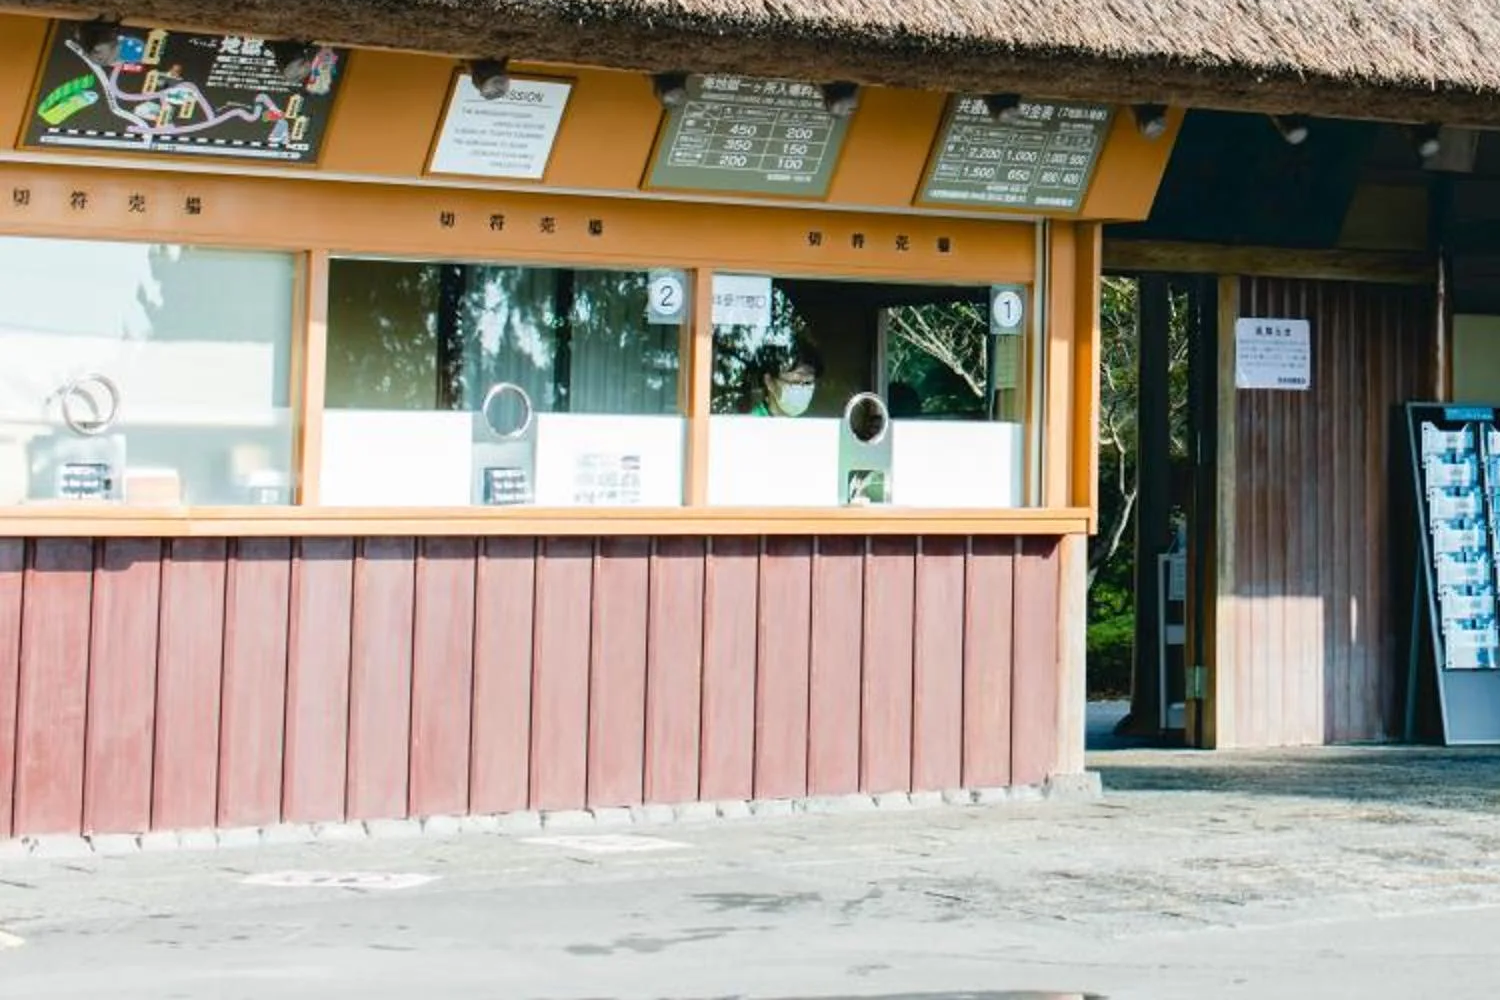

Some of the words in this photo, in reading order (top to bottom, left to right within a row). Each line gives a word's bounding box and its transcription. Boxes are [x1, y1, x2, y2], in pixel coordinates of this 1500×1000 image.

[729, 123, 758, 137] 450
[784, 127, 813, 140] 200
[723, 139, 753, 152] 350
[782, 143, 808, 155] 150
[718, 155, 748, 167] 200
[777, 158, 803, 170] 100
[660, 285, 674, 307] 2
